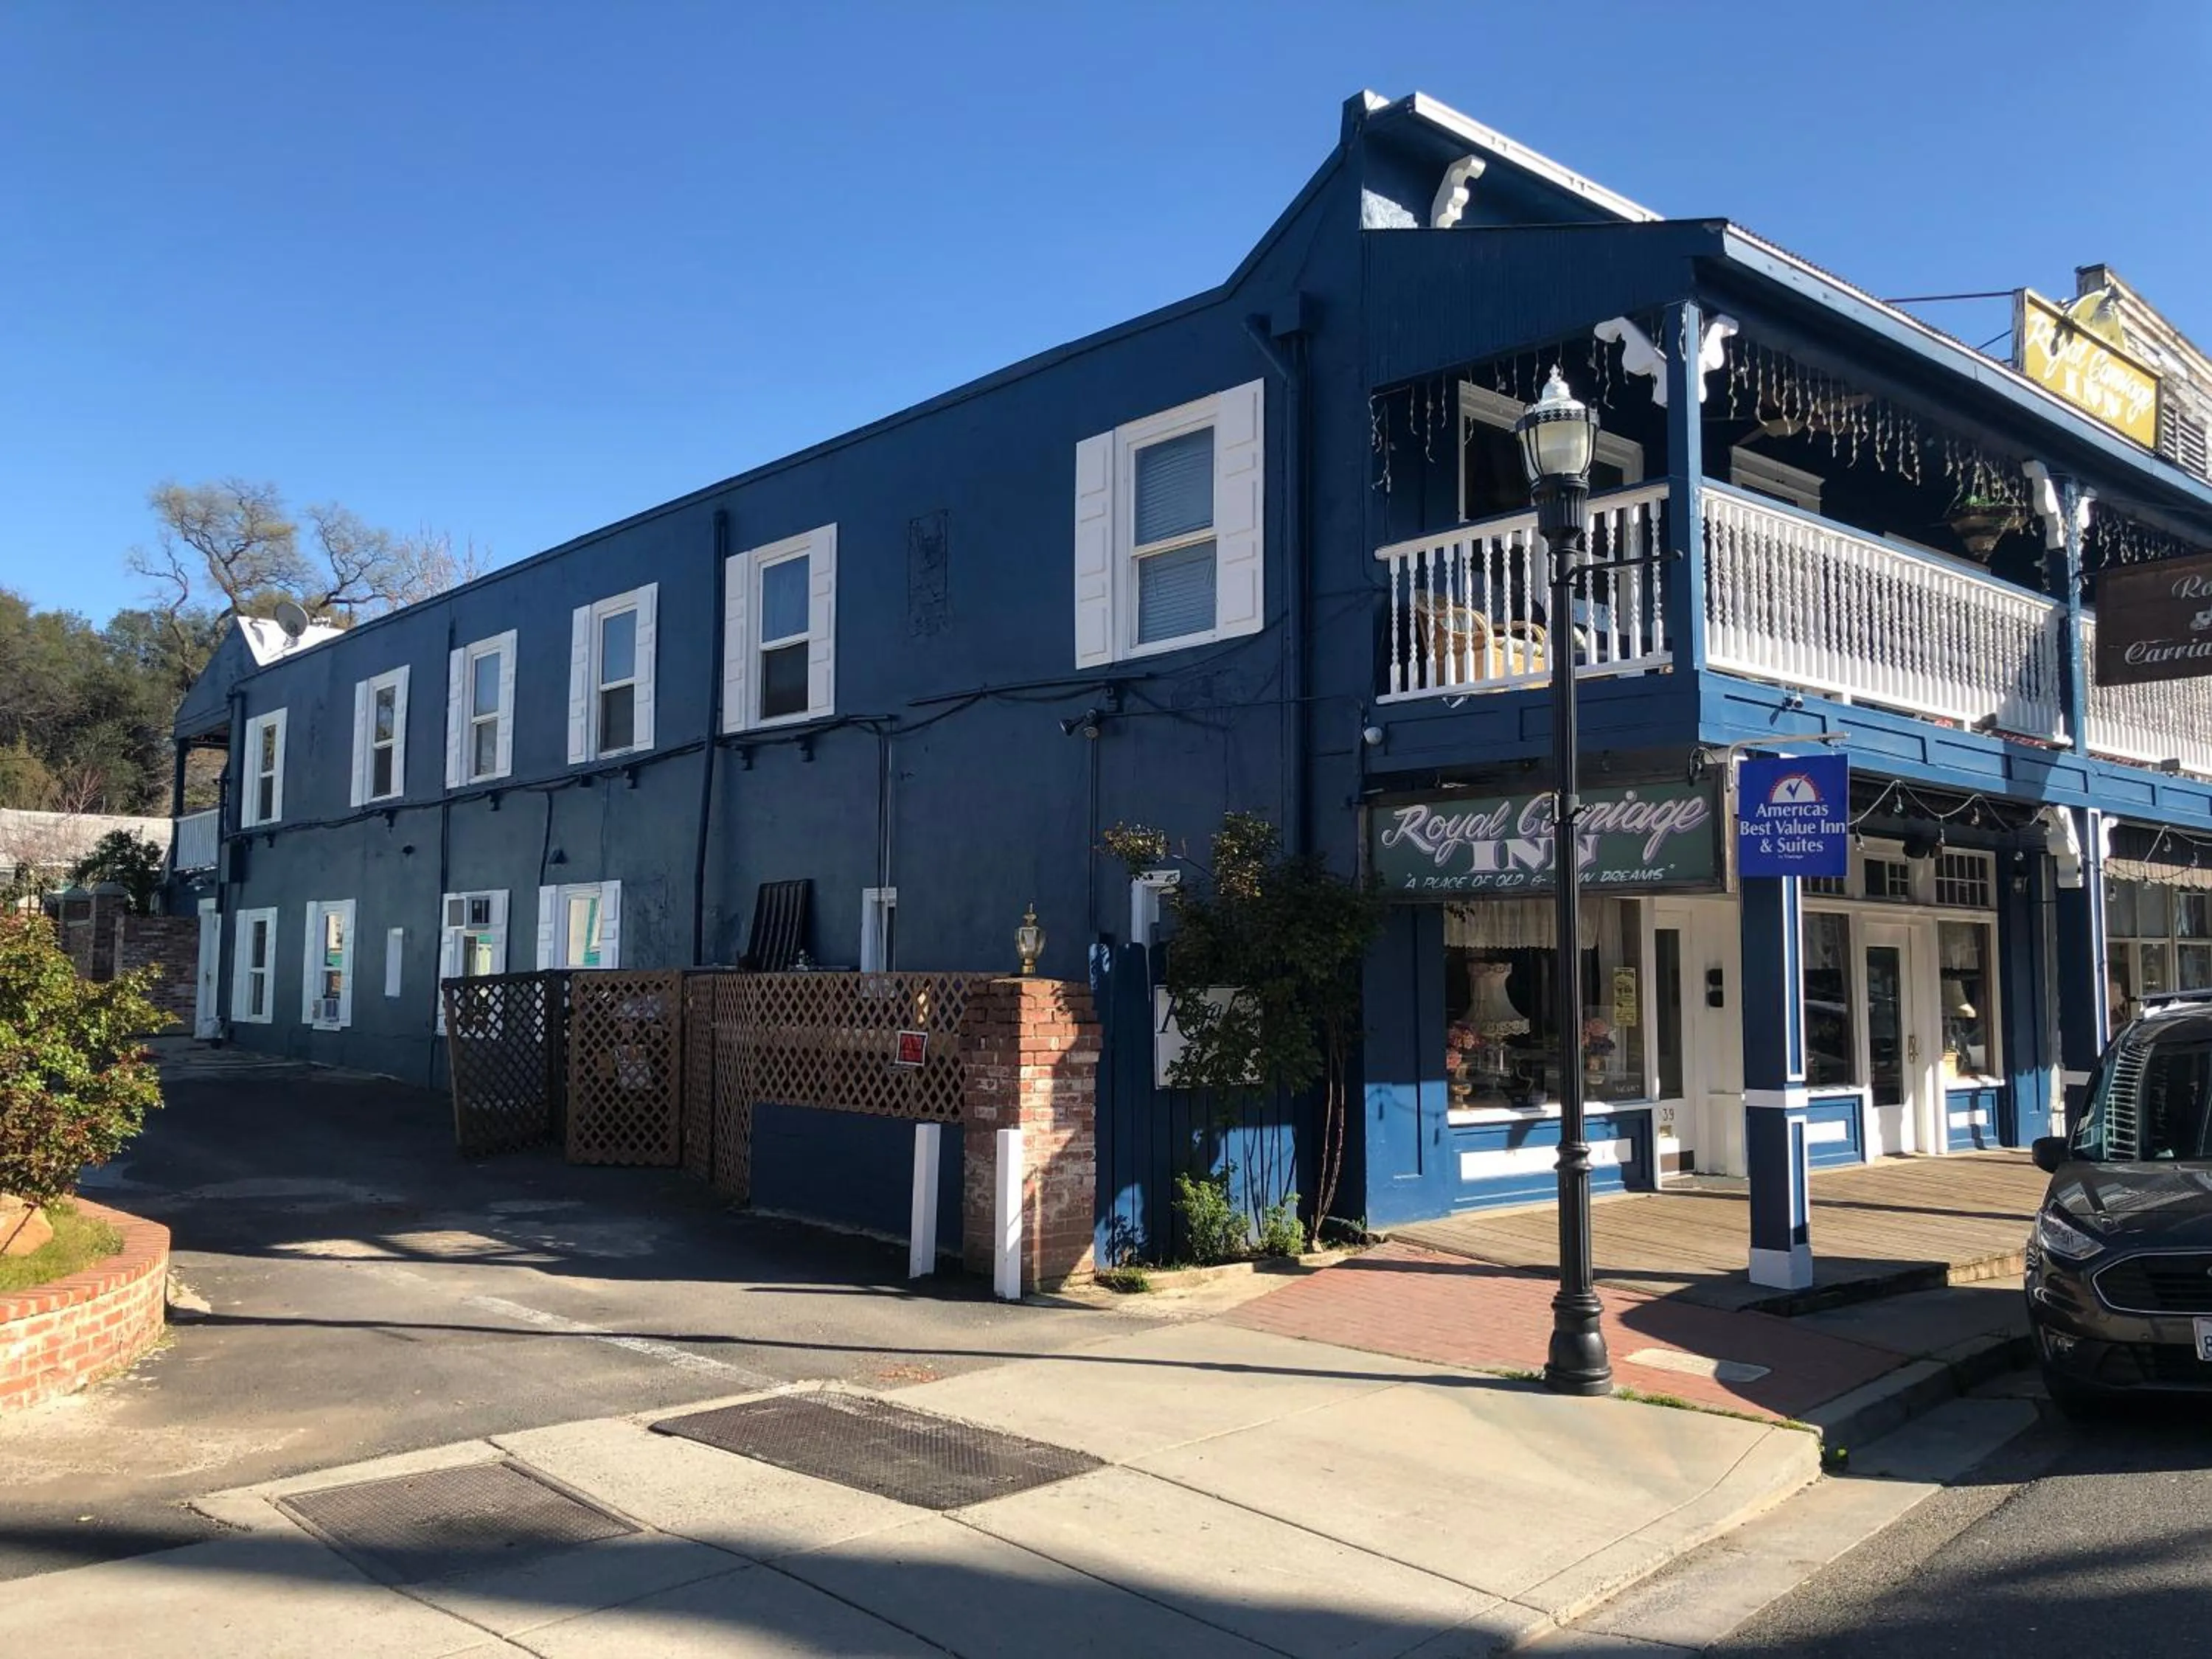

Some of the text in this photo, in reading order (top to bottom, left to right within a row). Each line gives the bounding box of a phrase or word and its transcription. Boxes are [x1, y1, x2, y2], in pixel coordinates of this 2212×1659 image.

[1756, 803, 1829, 818] Americas
[1381, 790, 1710, 866] Royal Criage
[1740, 818, 1846, 835] Best Value Inn
[1759, 837, 1824, 853] & Suites
[1423, 876, 1467, 889] PLACE
[1472, 875, 1492, 887] OF
[1496, 874, 1524, 887] OLD
